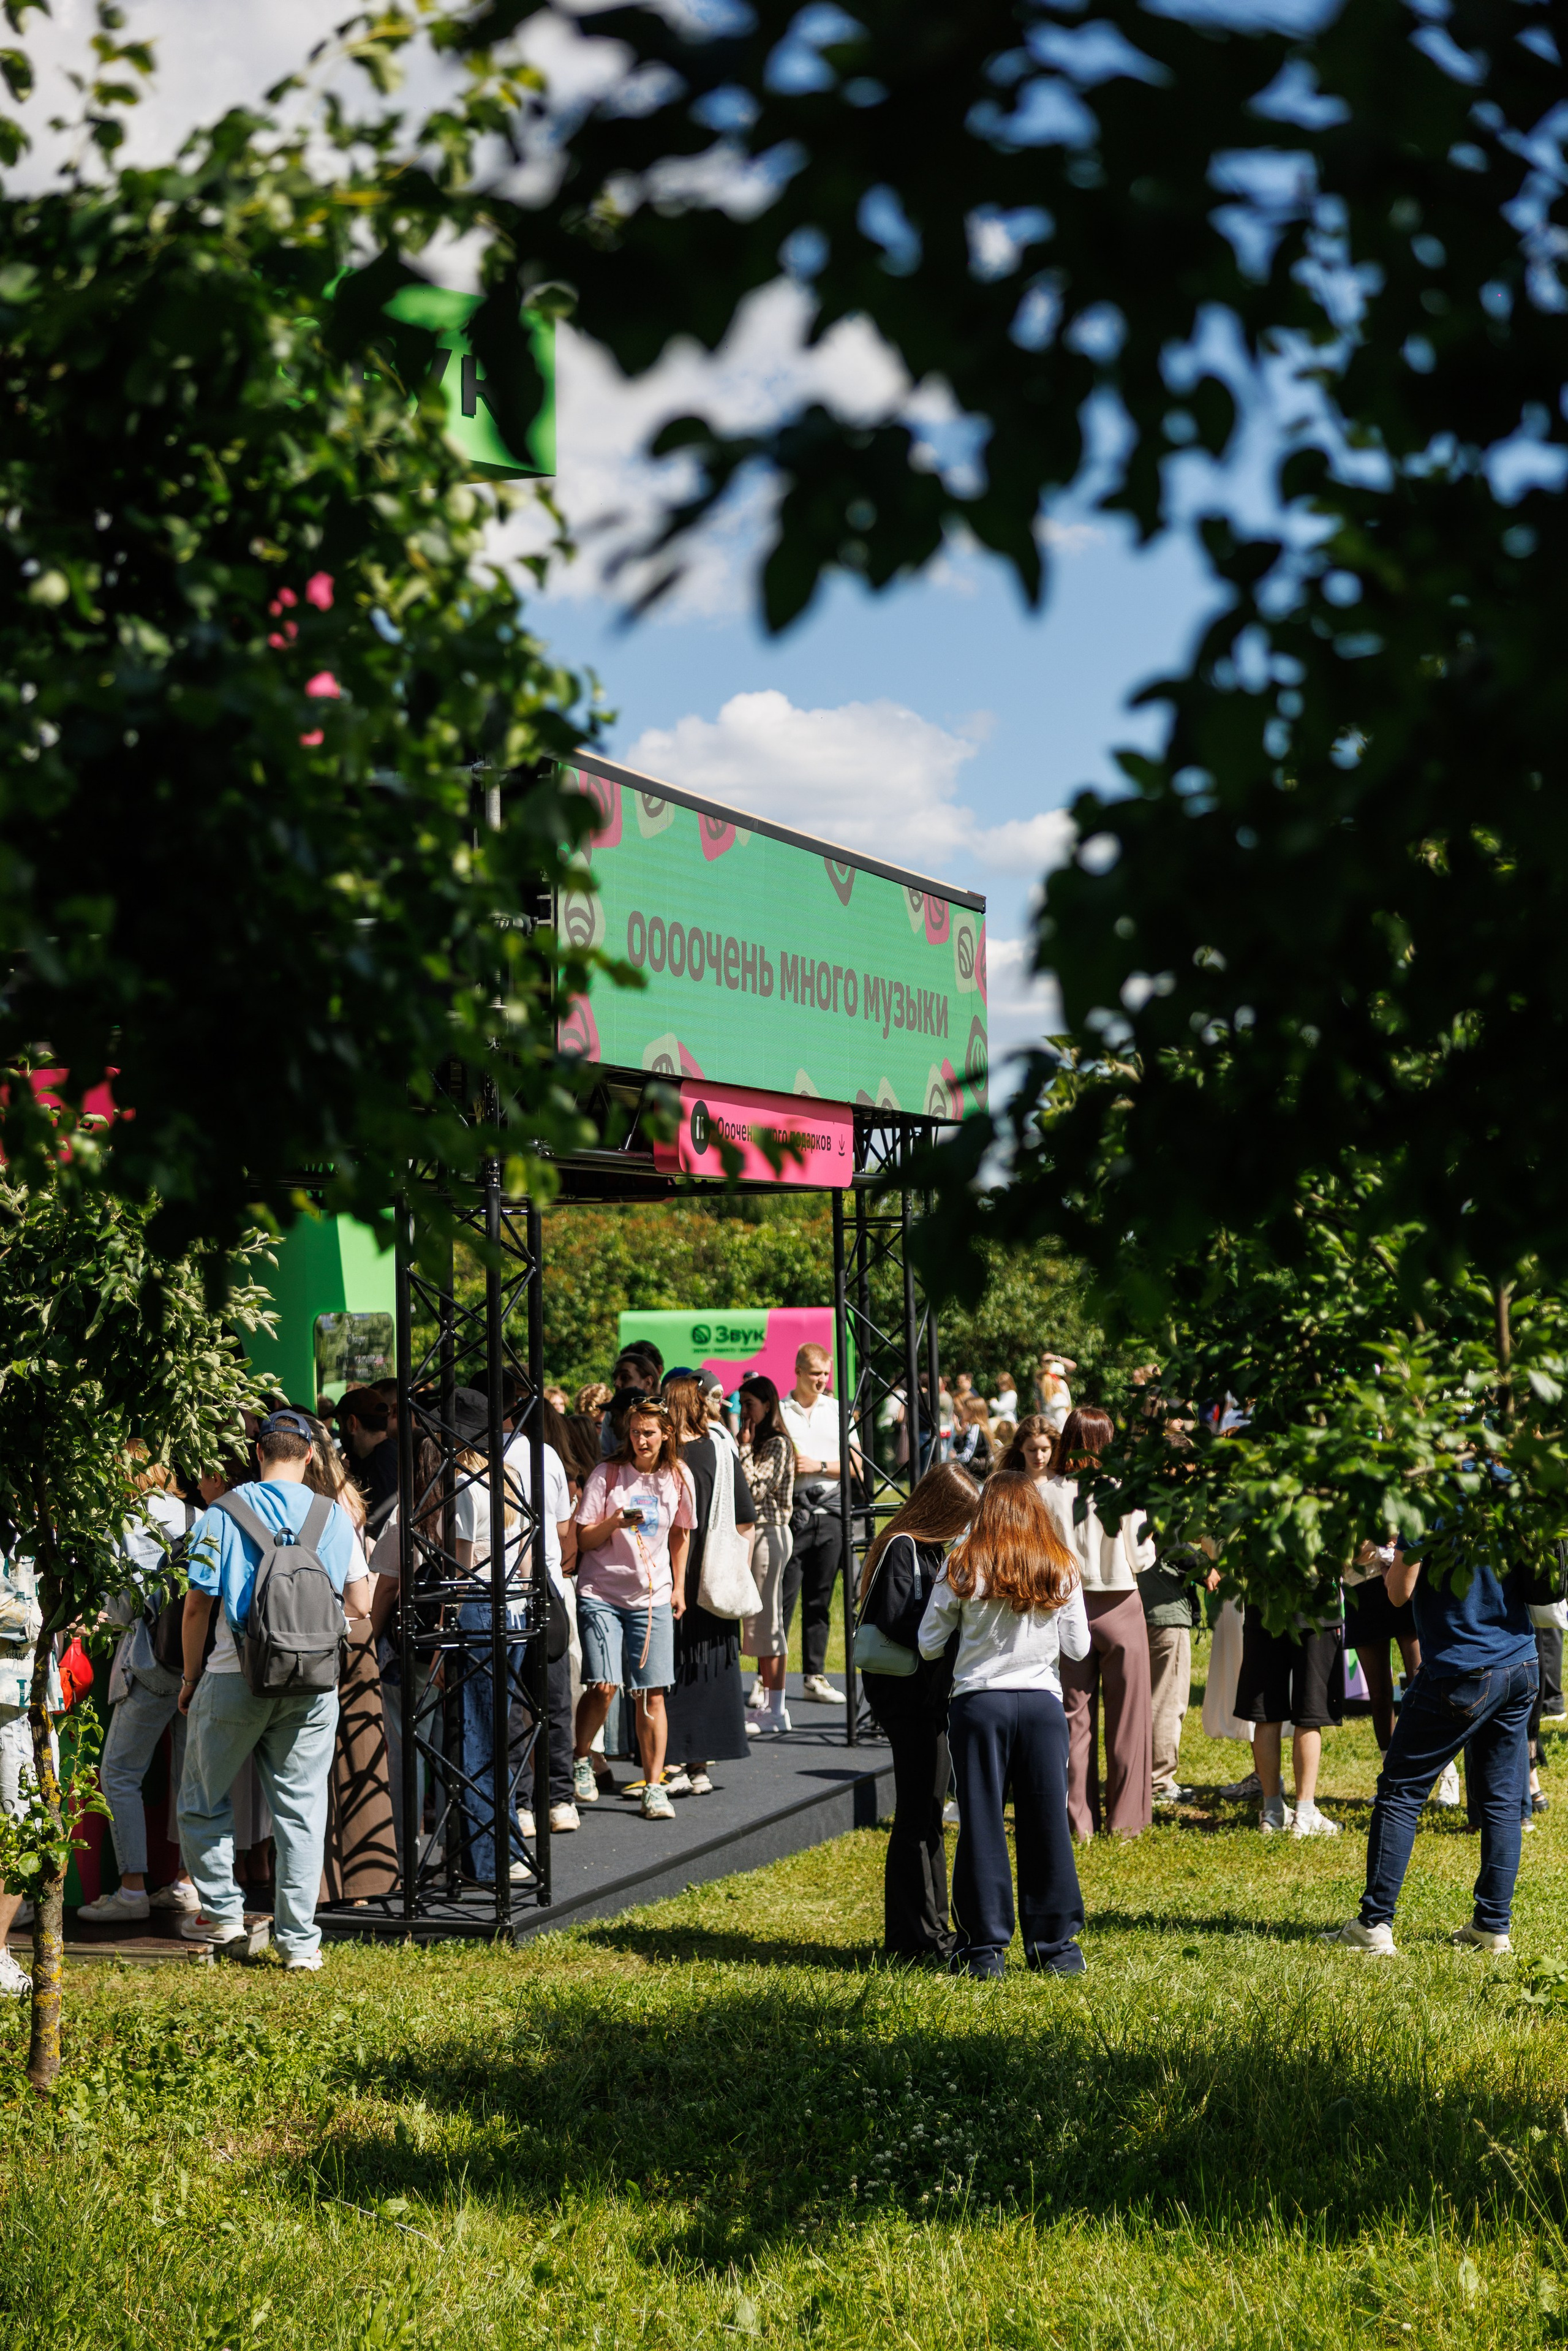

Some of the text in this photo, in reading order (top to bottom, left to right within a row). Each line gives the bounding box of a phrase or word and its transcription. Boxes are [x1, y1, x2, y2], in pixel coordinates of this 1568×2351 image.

[627, 910, 949, 1040] оооочень много музыки
[717, 1117, 758, 1143] Ооочен
[715, 1325, 765, 1345] Звук
